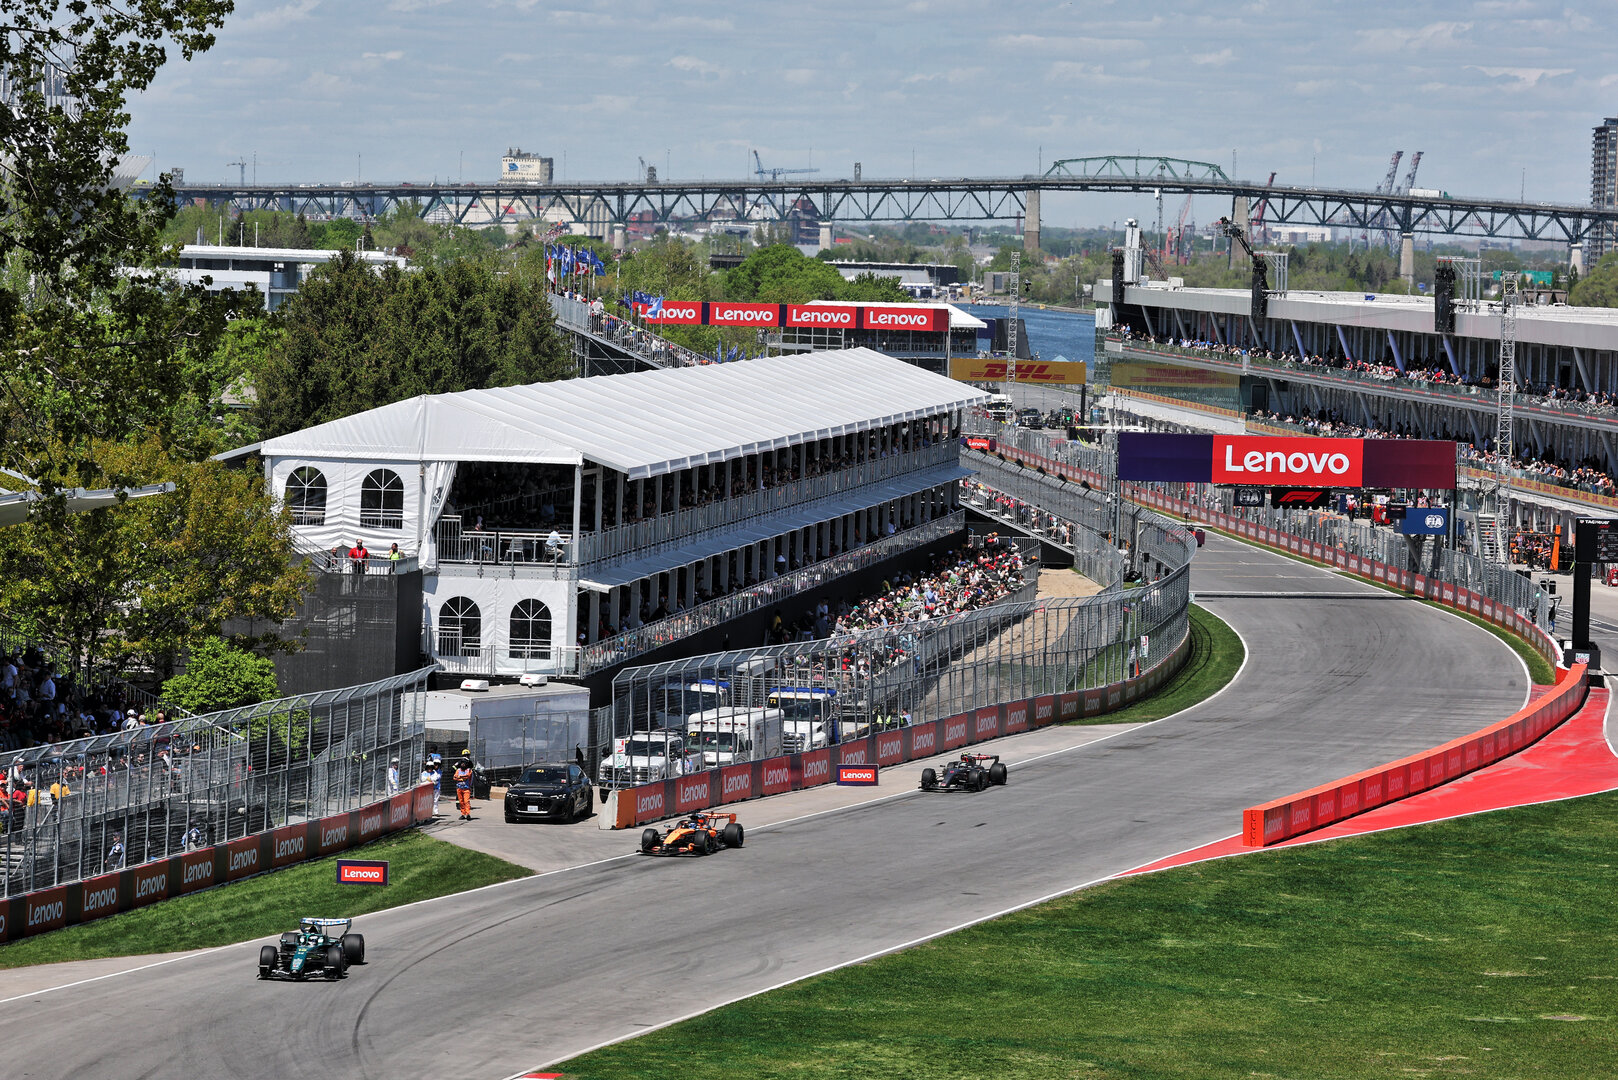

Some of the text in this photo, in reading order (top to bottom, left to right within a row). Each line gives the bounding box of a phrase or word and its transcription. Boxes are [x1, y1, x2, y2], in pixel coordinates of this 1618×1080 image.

[715, 307, 773, 321] Lenovo
[792, 309, 850, 323] Lenovo
[869, 311, 928, 325] Lenovo
[983, 363, 1052, 379] DHL
[1225, 444, 1350, 474] Lenovo
[1425, 517, 1442, 526] FIA
[1035, 703, 1052, 719] Lenovo
[1061, 700, 1077, 715] Lenovo
[1084, 696, 1100, 711] Lenovo
[976, 714, 997, 733] Lenovo
[1007, 708, 1026, 726] Lenovo
[913, 732, 935, 751] Lenovo
[945, 722, 966, 742] Lenovo
[879, 739, 901, 759] Lenovo
[764, 767, 789, 786] Lenovo
[803, 759, 828, 778] Lenovo
[842, 771, 872, 779] Lenovo
[680, 783, 708, 803] Lenovo
[724, 773, 750, 794] Lenovo
[637, 793, 663, 813] Lenovo
[1318, 799, 1334, 817] Lenovo
[1342, 791, 1358, 809] Lenovo
[391, 803, 409, 823] Lenovo
[1292, 807, 1310, 825] Lenovo
[360, 814, 380, 835] Lenovo
[1264, 816, 1283, 834] Lenovo
[321, 825, 347, 847] Lenovo
[275, 836, 304, 858] Lenovo
[229, 848, 257, 871] Lenovo
[183, 860, 212, 883] Lenovo
[344, 869, 380, 878] Lenovo
[136, 873, 166, 898] Lenovo
[84, 887, 117, 912] Lenovo
[28, 900, 63, 926] Lenovo
